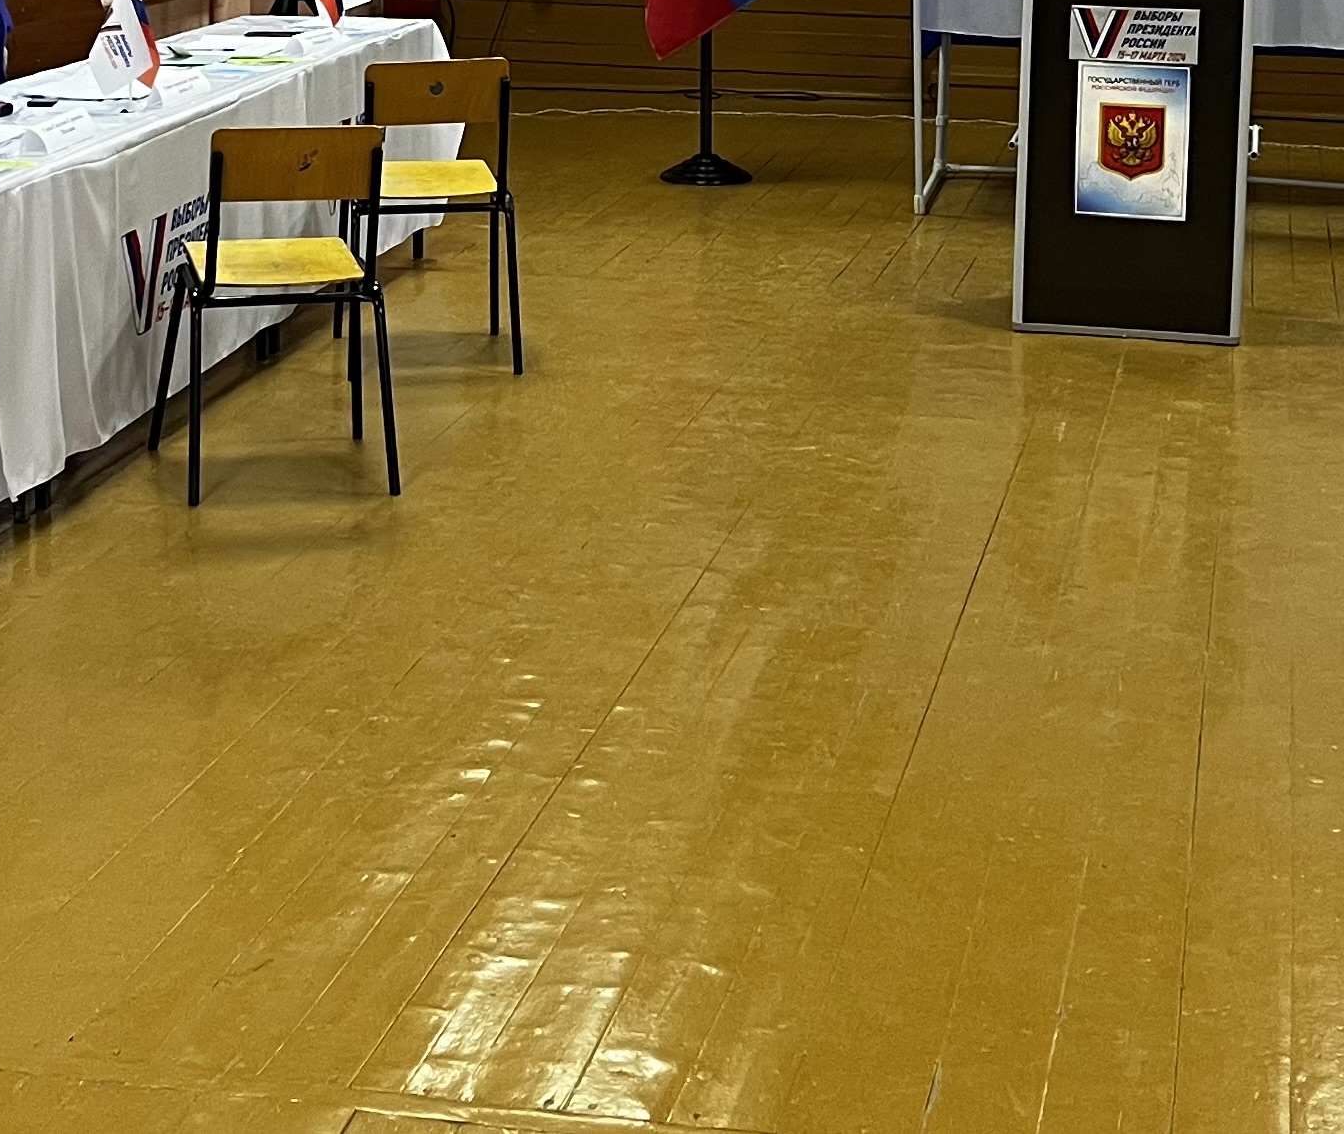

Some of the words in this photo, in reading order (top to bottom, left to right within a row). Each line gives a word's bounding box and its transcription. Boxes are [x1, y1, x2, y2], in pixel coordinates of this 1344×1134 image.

[1133, 11, 1183, 22] ВЫБОРЫ
[1127, 24, 1197, 37] ПРЕЗИДЕНТА
[1121, 38, 1166, 49] РОССИИ
[1139, 52, 1166, 61] МАРТА
[1167, 53, 1186, 61] 2024
[1088, 76, 1162, 85] ГОСУДАРСТВЕННЫЙ
[1164, 79, 1181, 87] ГЕРБ
